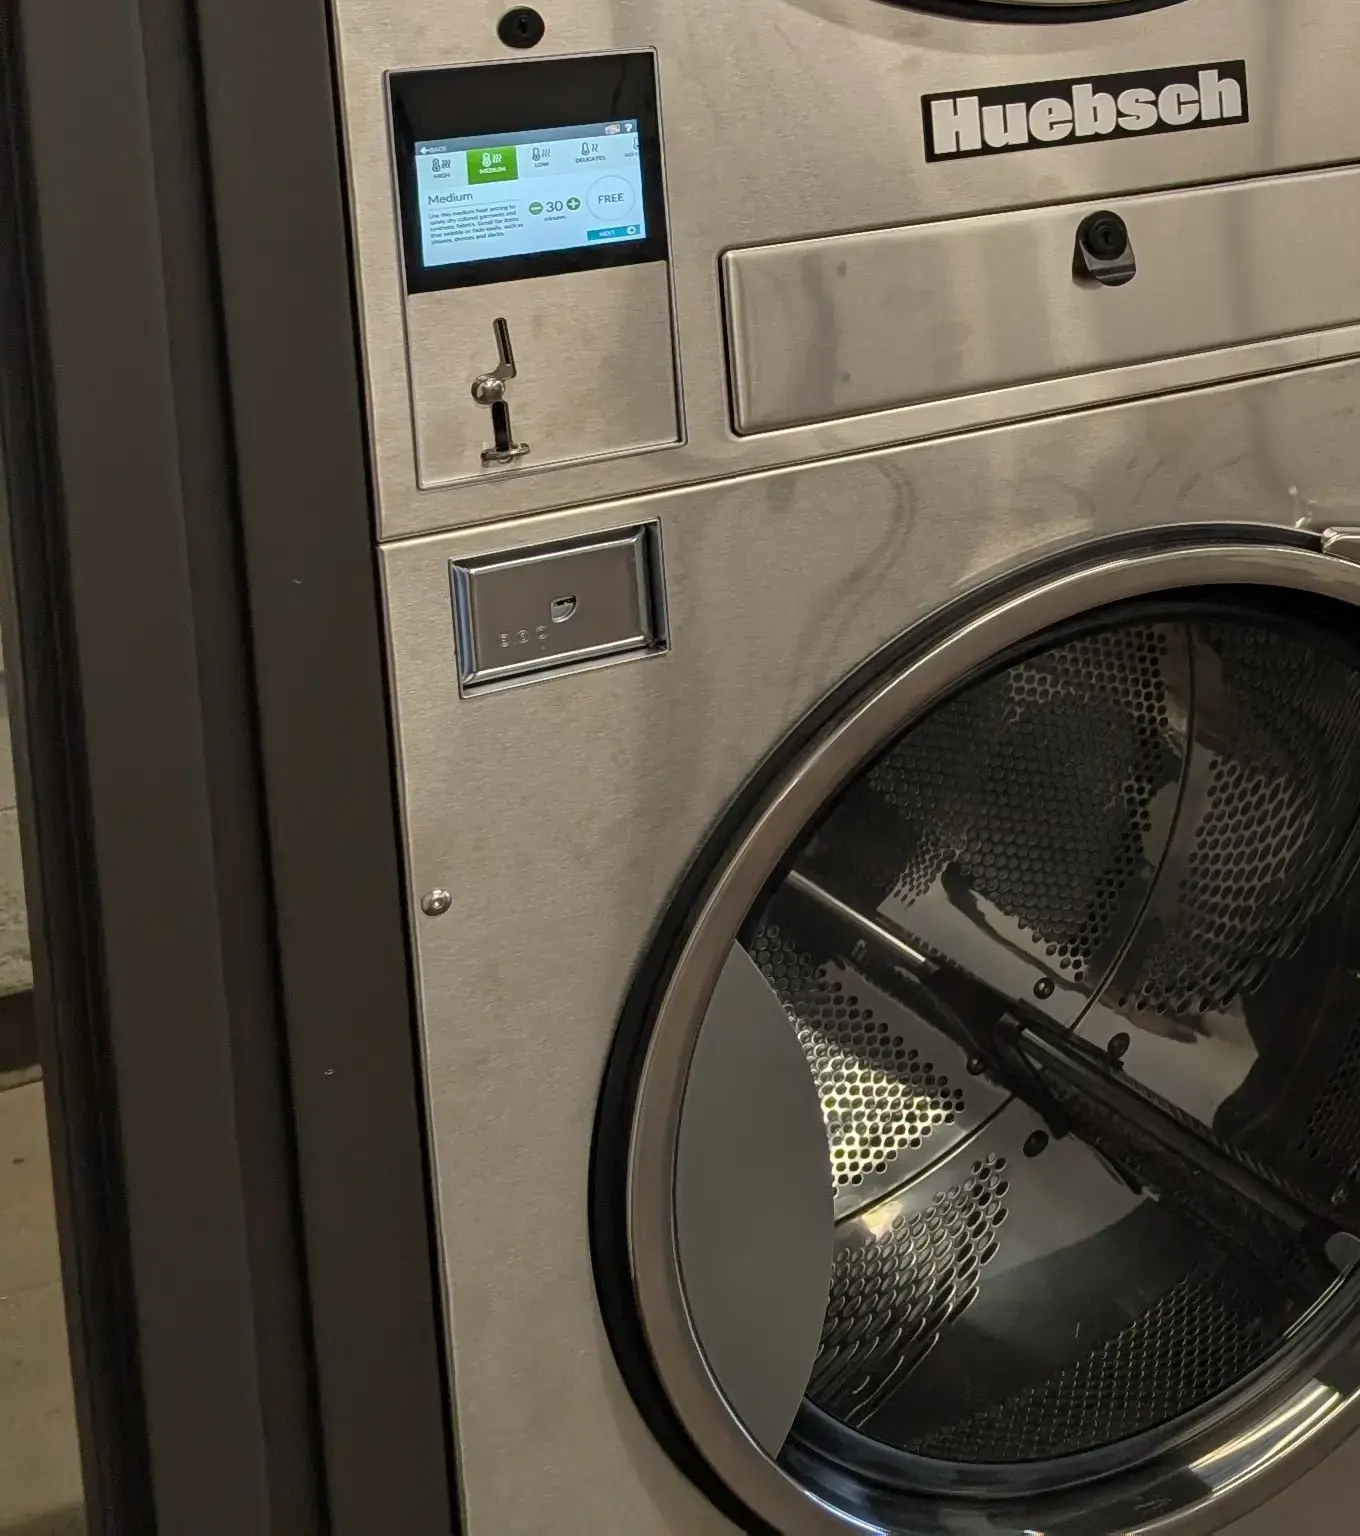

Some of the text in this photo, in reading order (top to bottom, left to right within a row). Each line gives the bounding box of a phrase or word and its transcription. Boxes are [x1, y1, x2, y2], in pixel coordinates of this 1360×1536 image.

[930, 69, 1242, 155] Huebsch
[428, 193, 473, 204] Medium
[598, 193, 625, 204] FREE
[545, 200, 564, 213] 30
